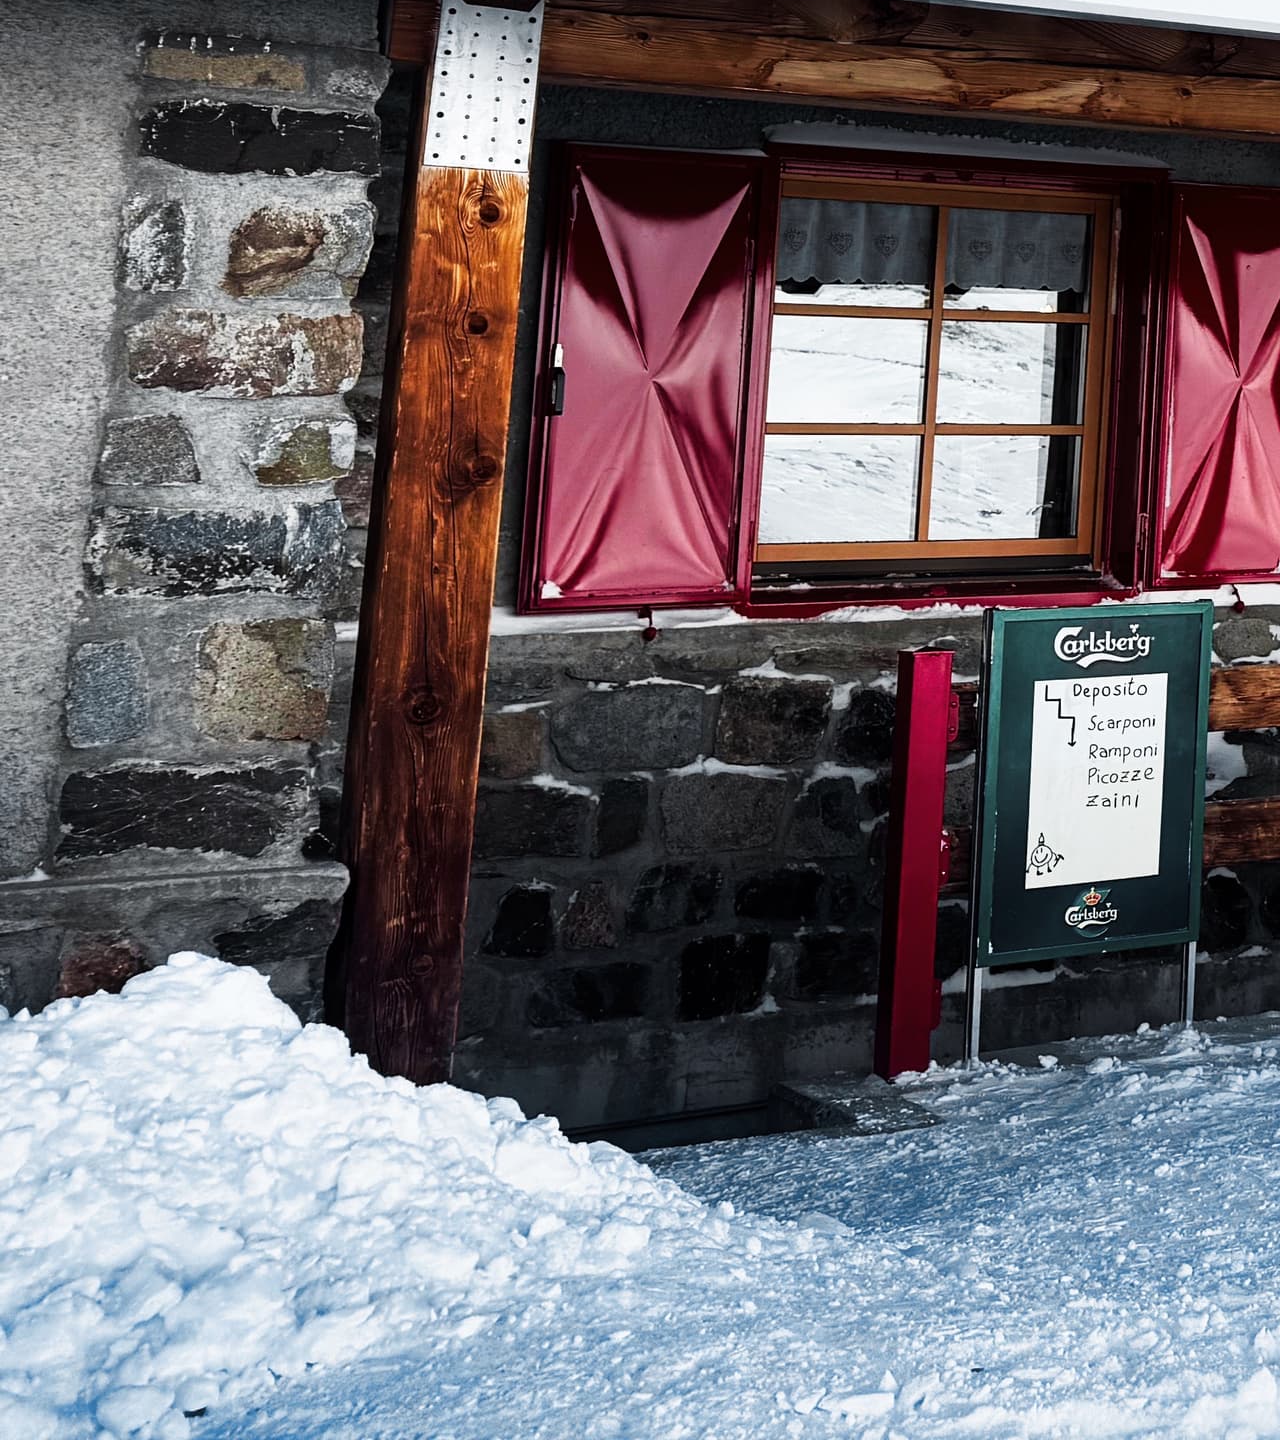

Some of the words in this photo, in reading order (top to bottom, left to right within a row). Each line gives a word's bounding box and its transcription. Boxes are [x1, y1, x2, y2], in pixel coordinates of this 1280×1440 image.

[1053, 624, 1151, 667] Carlsberg
[1073, 677, 1148, 707] Deposito
[1087, 714, 1157, 735] Scarponi
[1088, 743, 1158, 764] Ramponi
[1088, 766, 1155, 785] Picozze
[1064, 902, 1118, 928] Carlsberg
